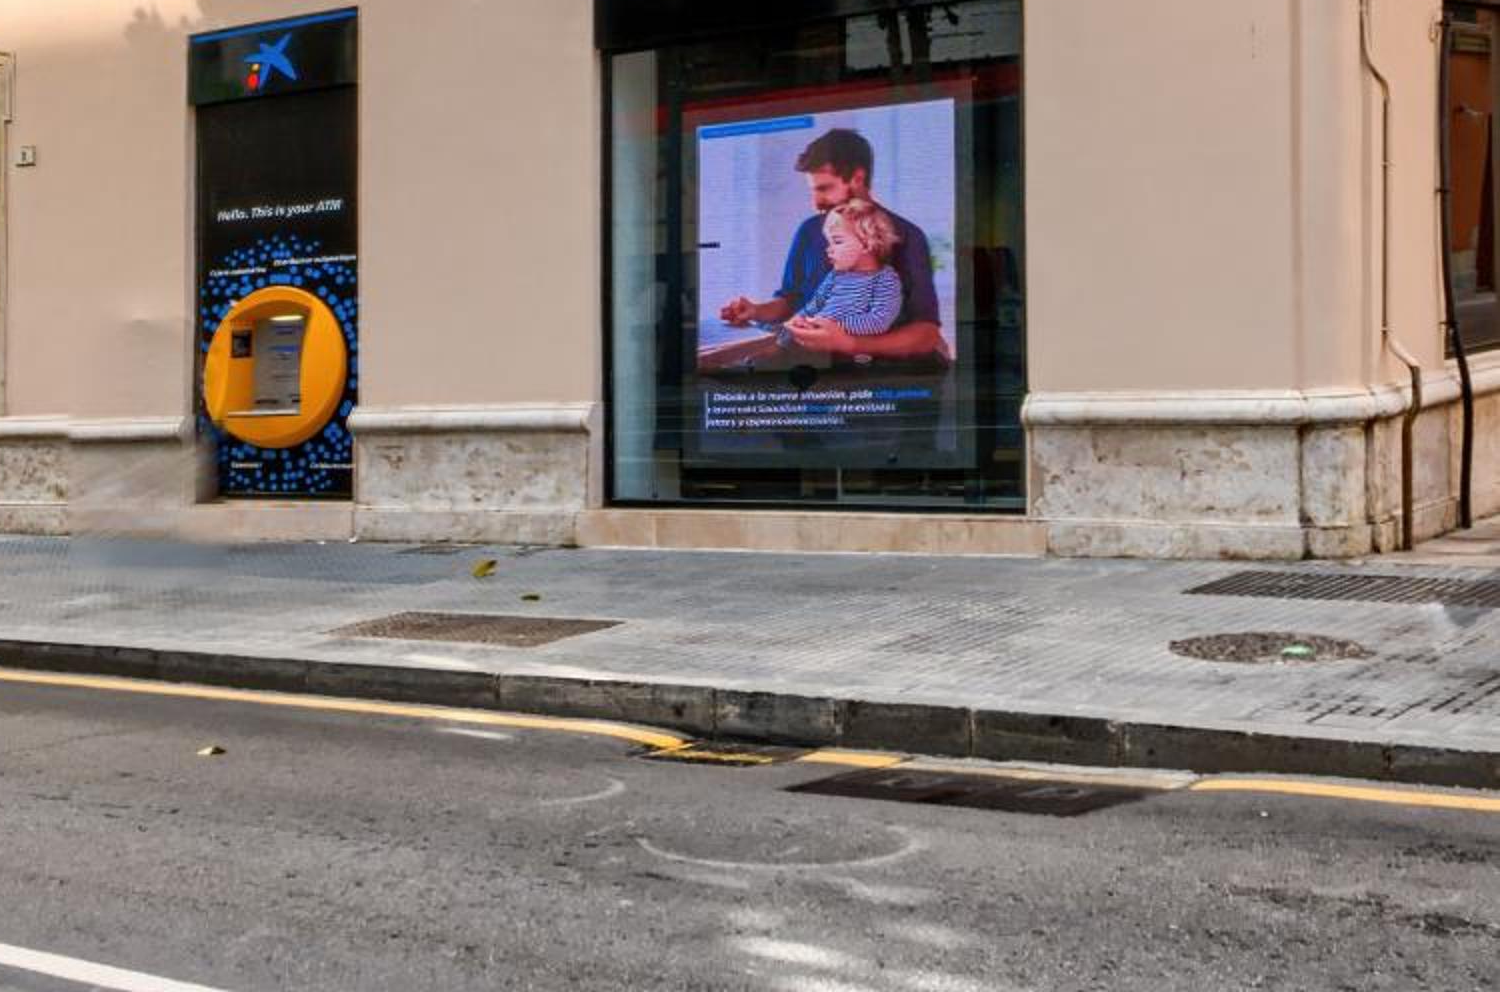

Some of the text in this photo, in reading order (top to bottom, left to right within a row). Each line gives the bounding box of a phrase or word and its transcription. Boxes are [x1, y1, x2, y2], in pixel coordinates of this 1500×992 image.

[251, 206, 273, 218] This
[286, 203, 314, 217] your
[315, 199, 342, 212] ATM
